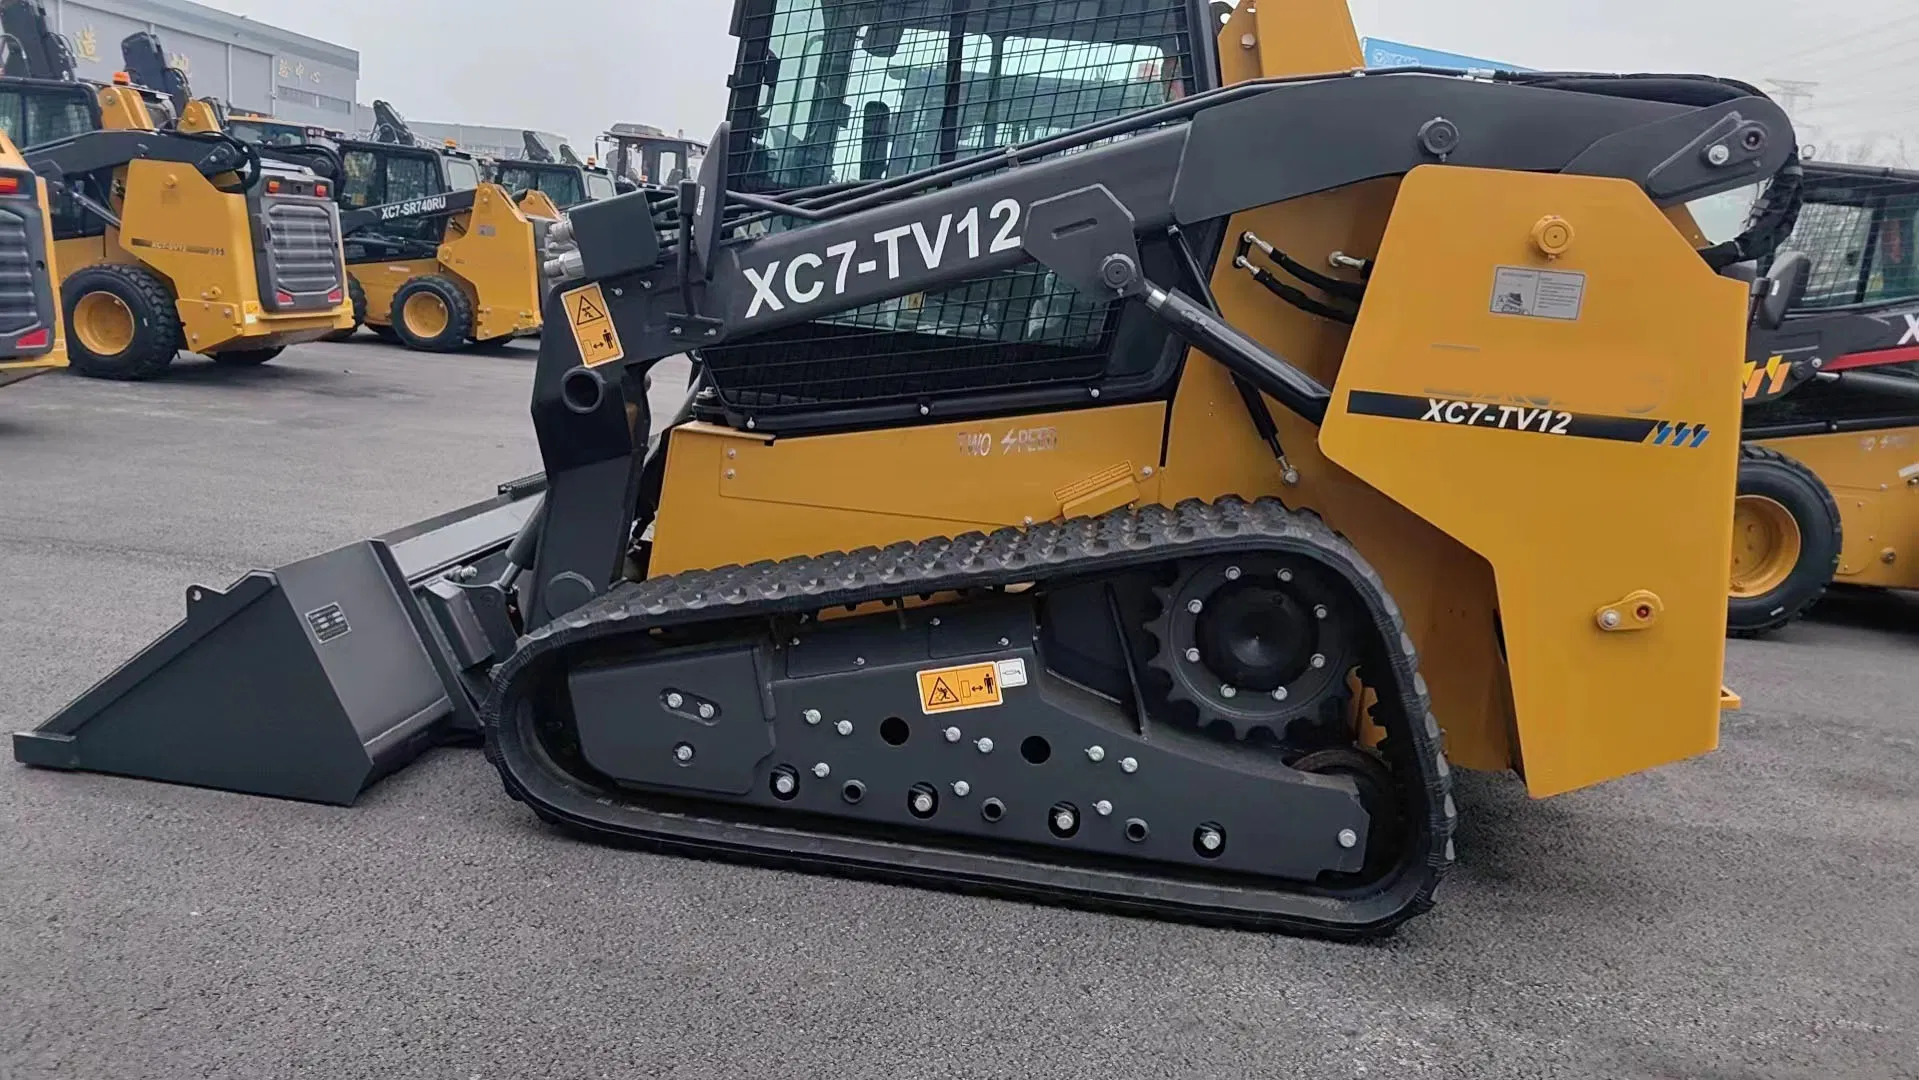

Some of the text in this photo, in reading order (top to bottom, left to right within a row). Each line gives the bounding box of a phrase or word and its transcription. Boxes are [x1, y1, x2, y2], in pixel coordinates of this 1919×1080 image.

[381, 196, 446, 219] XC7-SR740RU
[743, 198, 1021, 319] XC7-TV12
[1421, 398, 1573, 434] XC7-TV12
